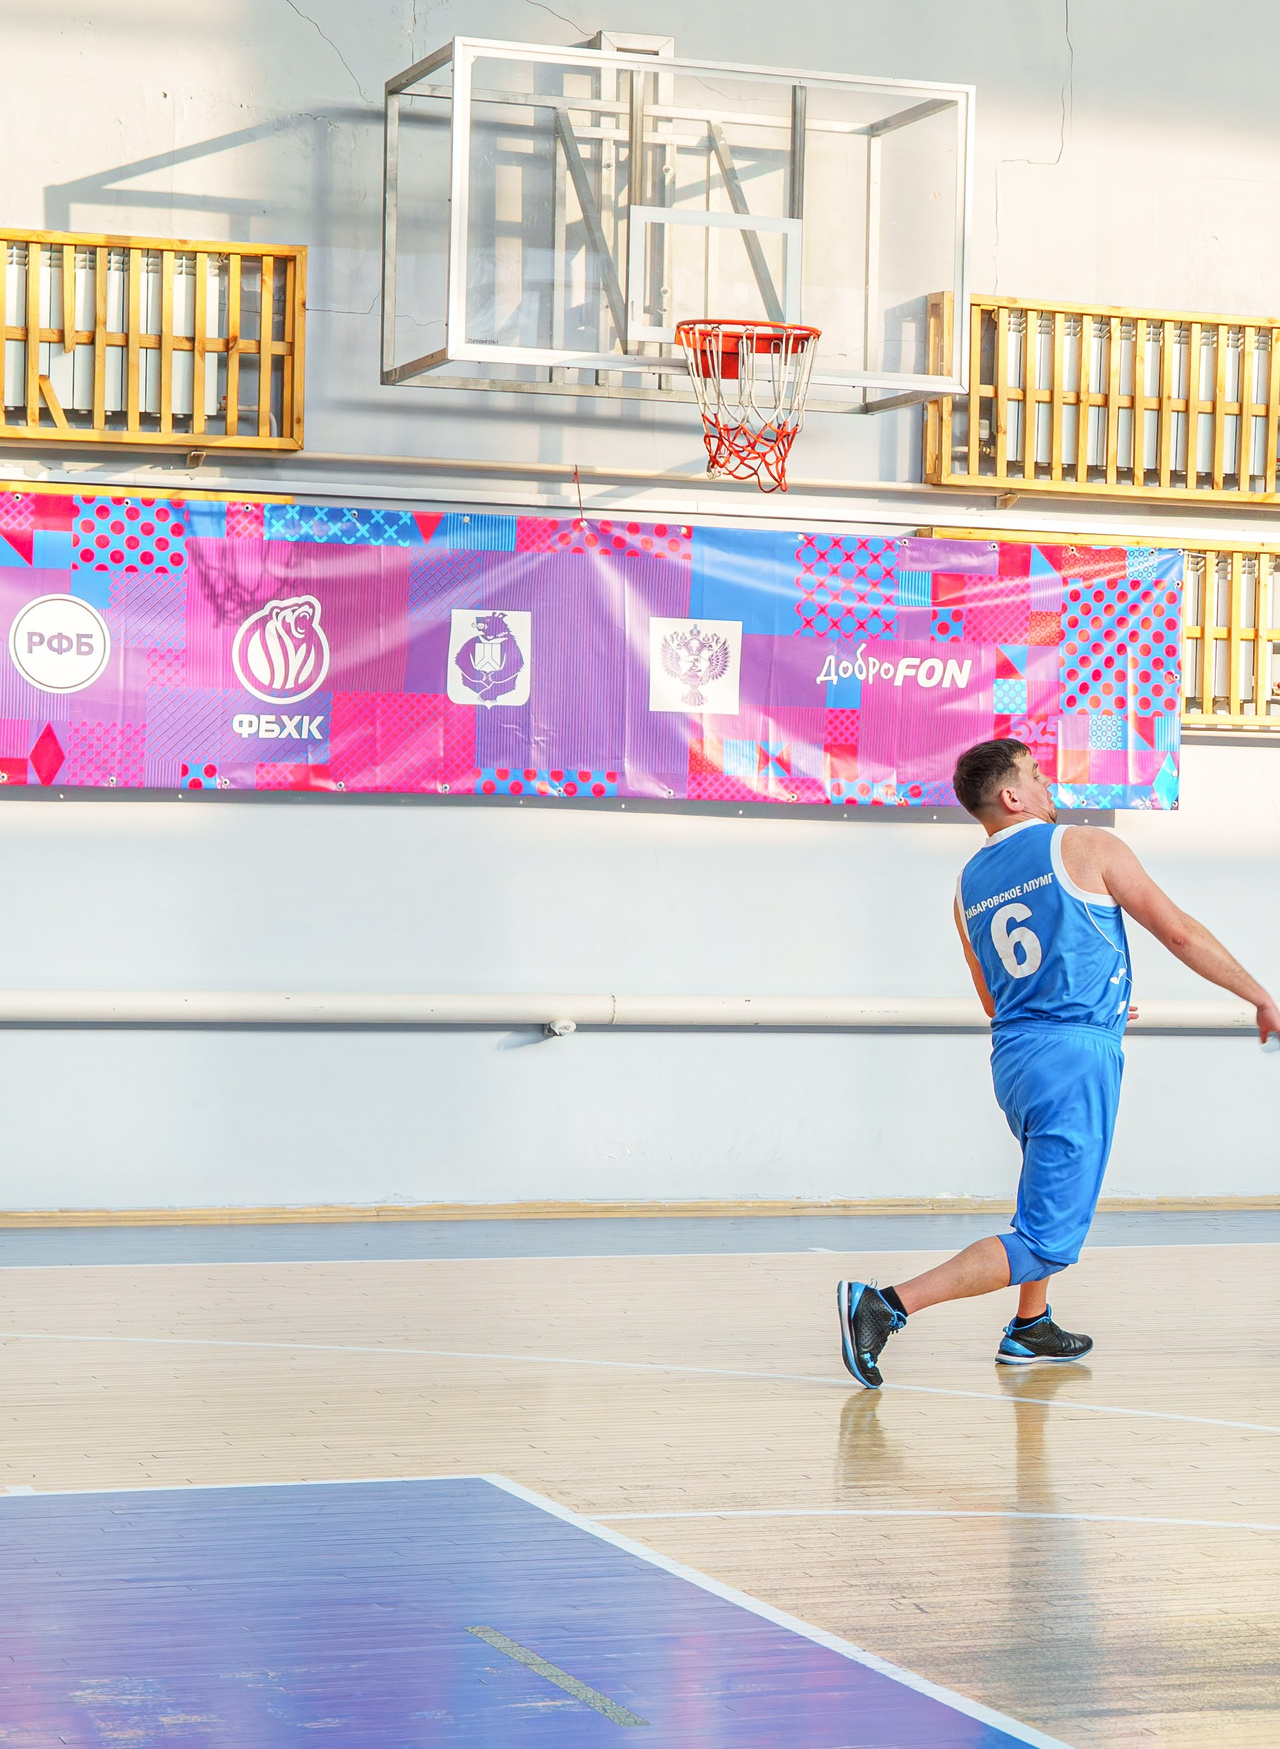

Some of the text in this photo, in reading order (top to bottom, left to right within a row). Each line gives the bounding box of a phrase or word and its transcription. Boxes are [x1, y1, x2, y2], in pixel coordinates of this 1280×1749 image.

[26, 631, 94, 656] РФБ
[816, 643, 972, 688] ДоброFON
[232, 714, 324, 739] ФБХК
[965, 873, 1054, 920] ХАБАРОВСКОЕ ЛПУМГ
[991, 903, 1042, 978] 6
